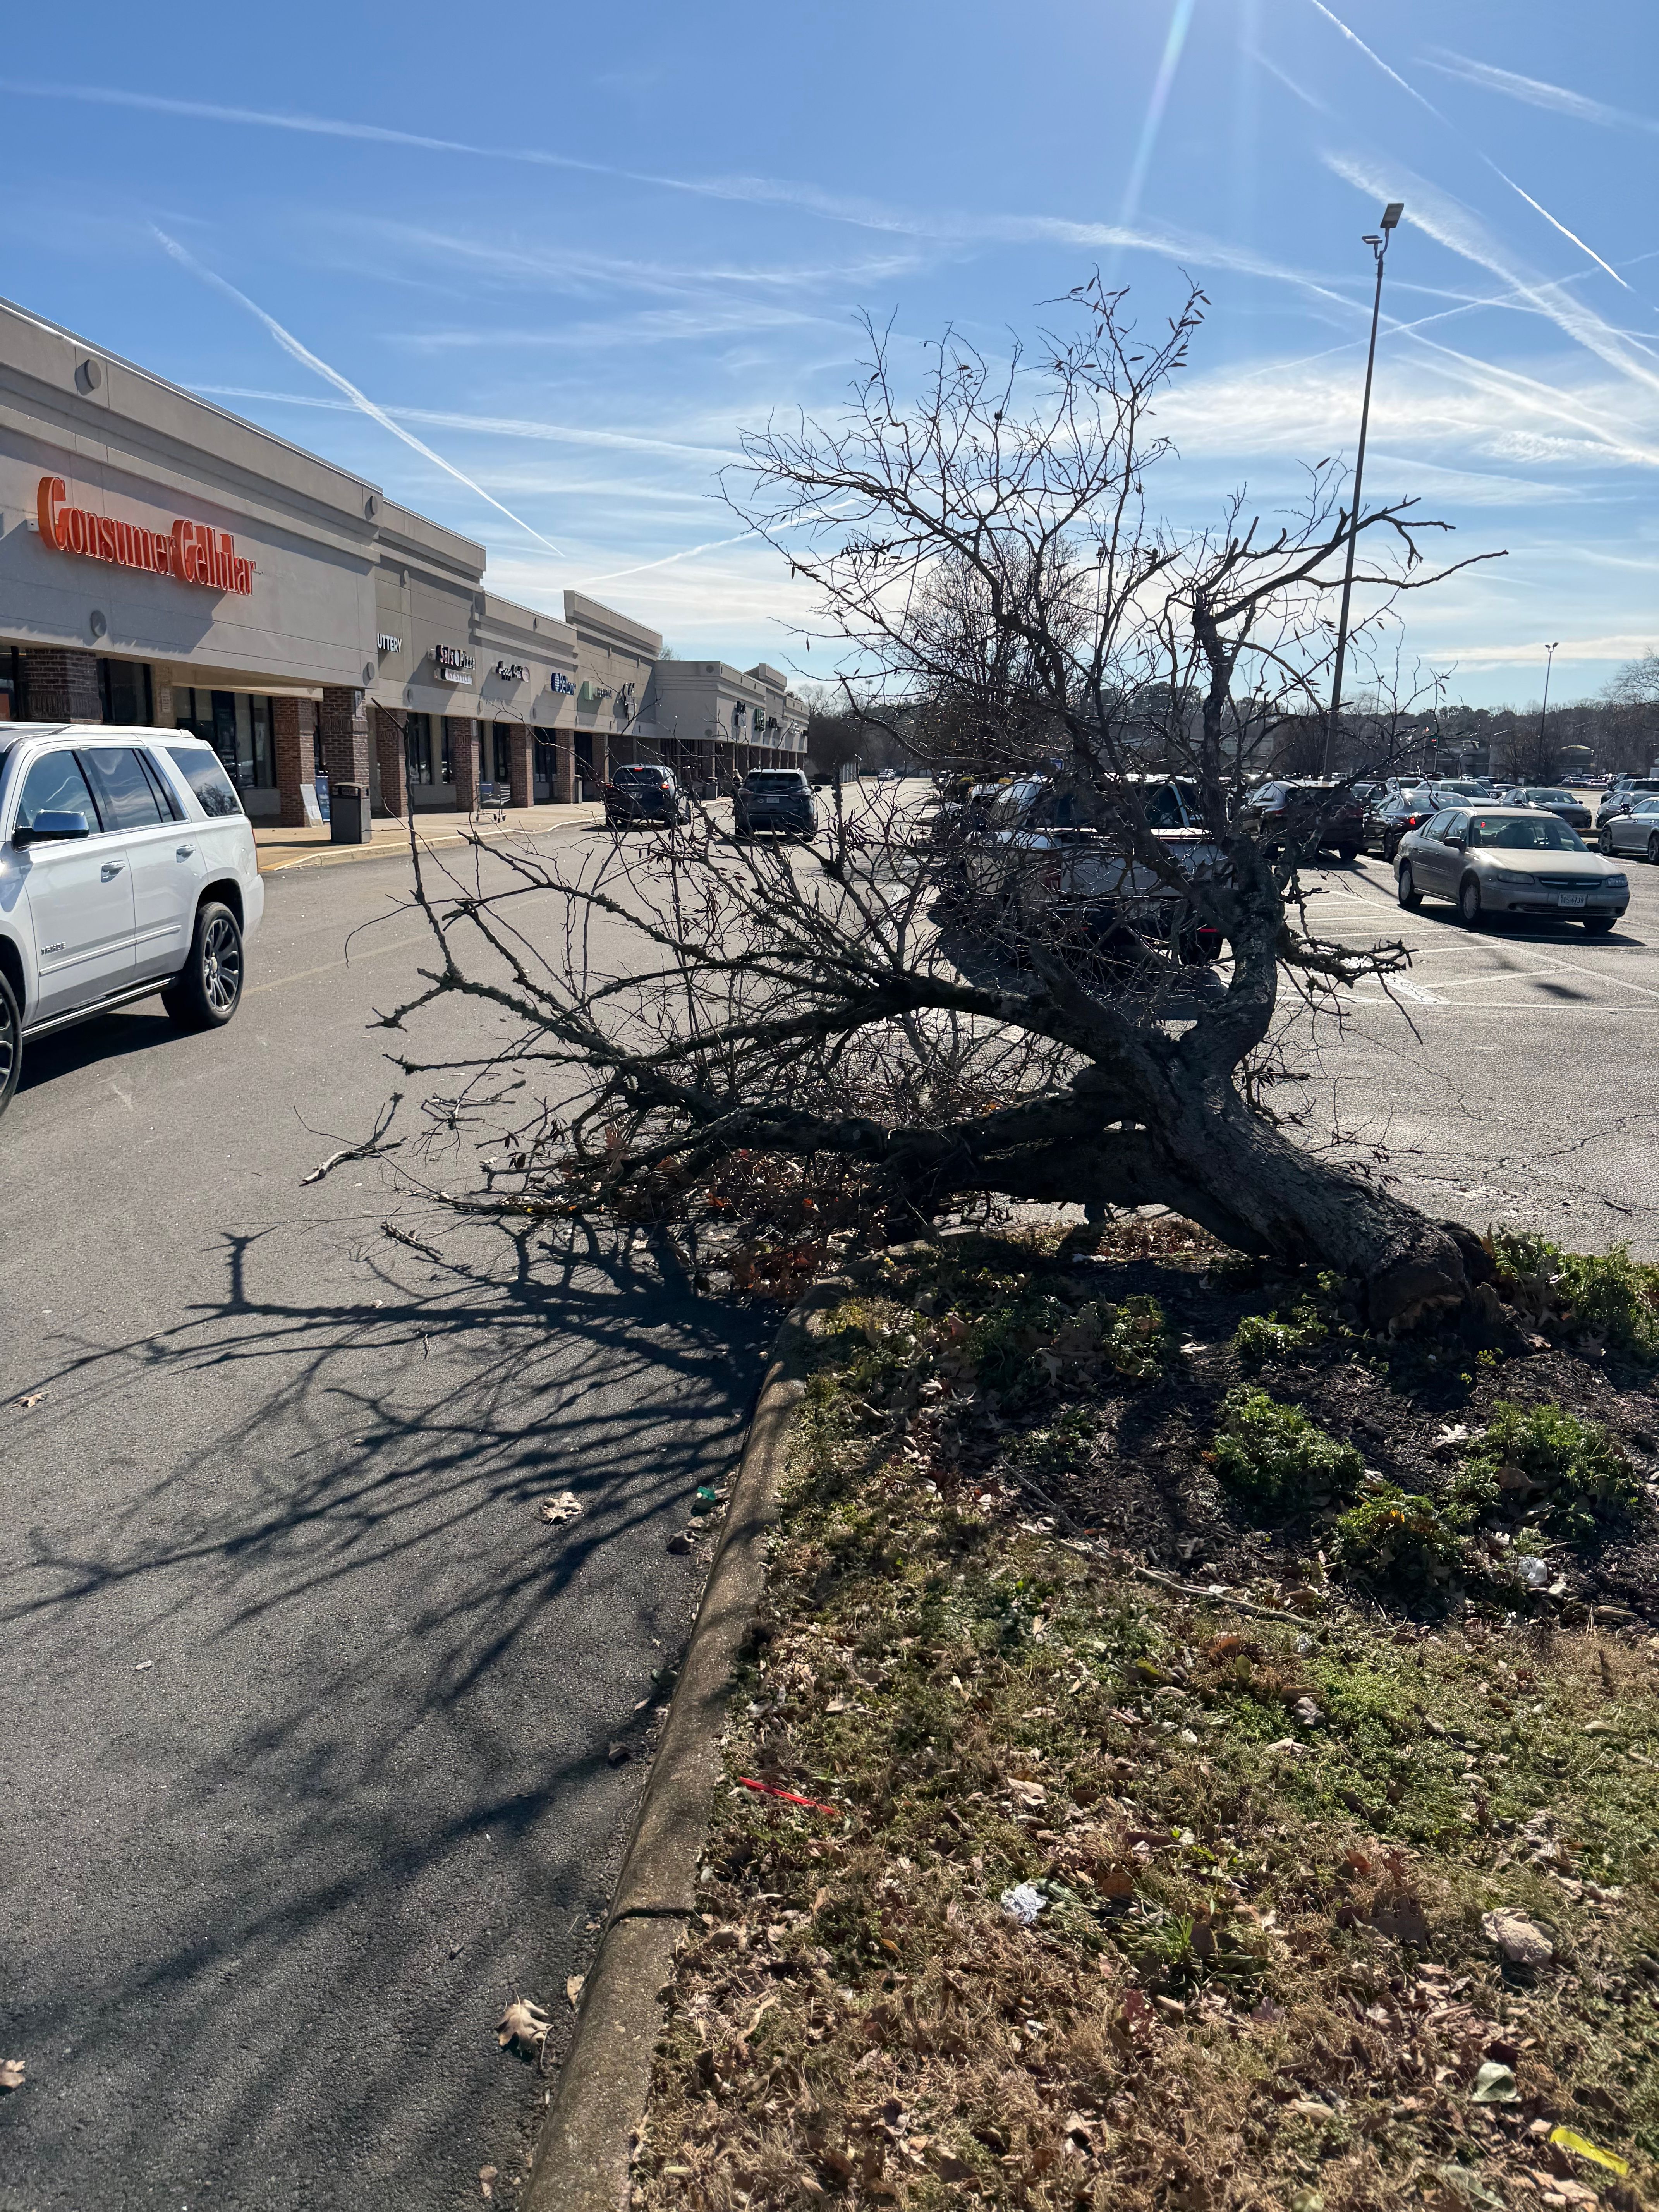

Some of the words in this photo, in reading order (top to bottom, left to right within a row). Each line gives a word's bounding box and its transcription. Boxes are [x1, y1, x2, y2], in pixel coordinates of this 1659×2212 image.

[37, 477, 176, 577] Consumer
[172, 519, 256, 596] Cellular
[377, 633, 402, 653] UTTERY
[460, 649, 476, 670] Pizza
